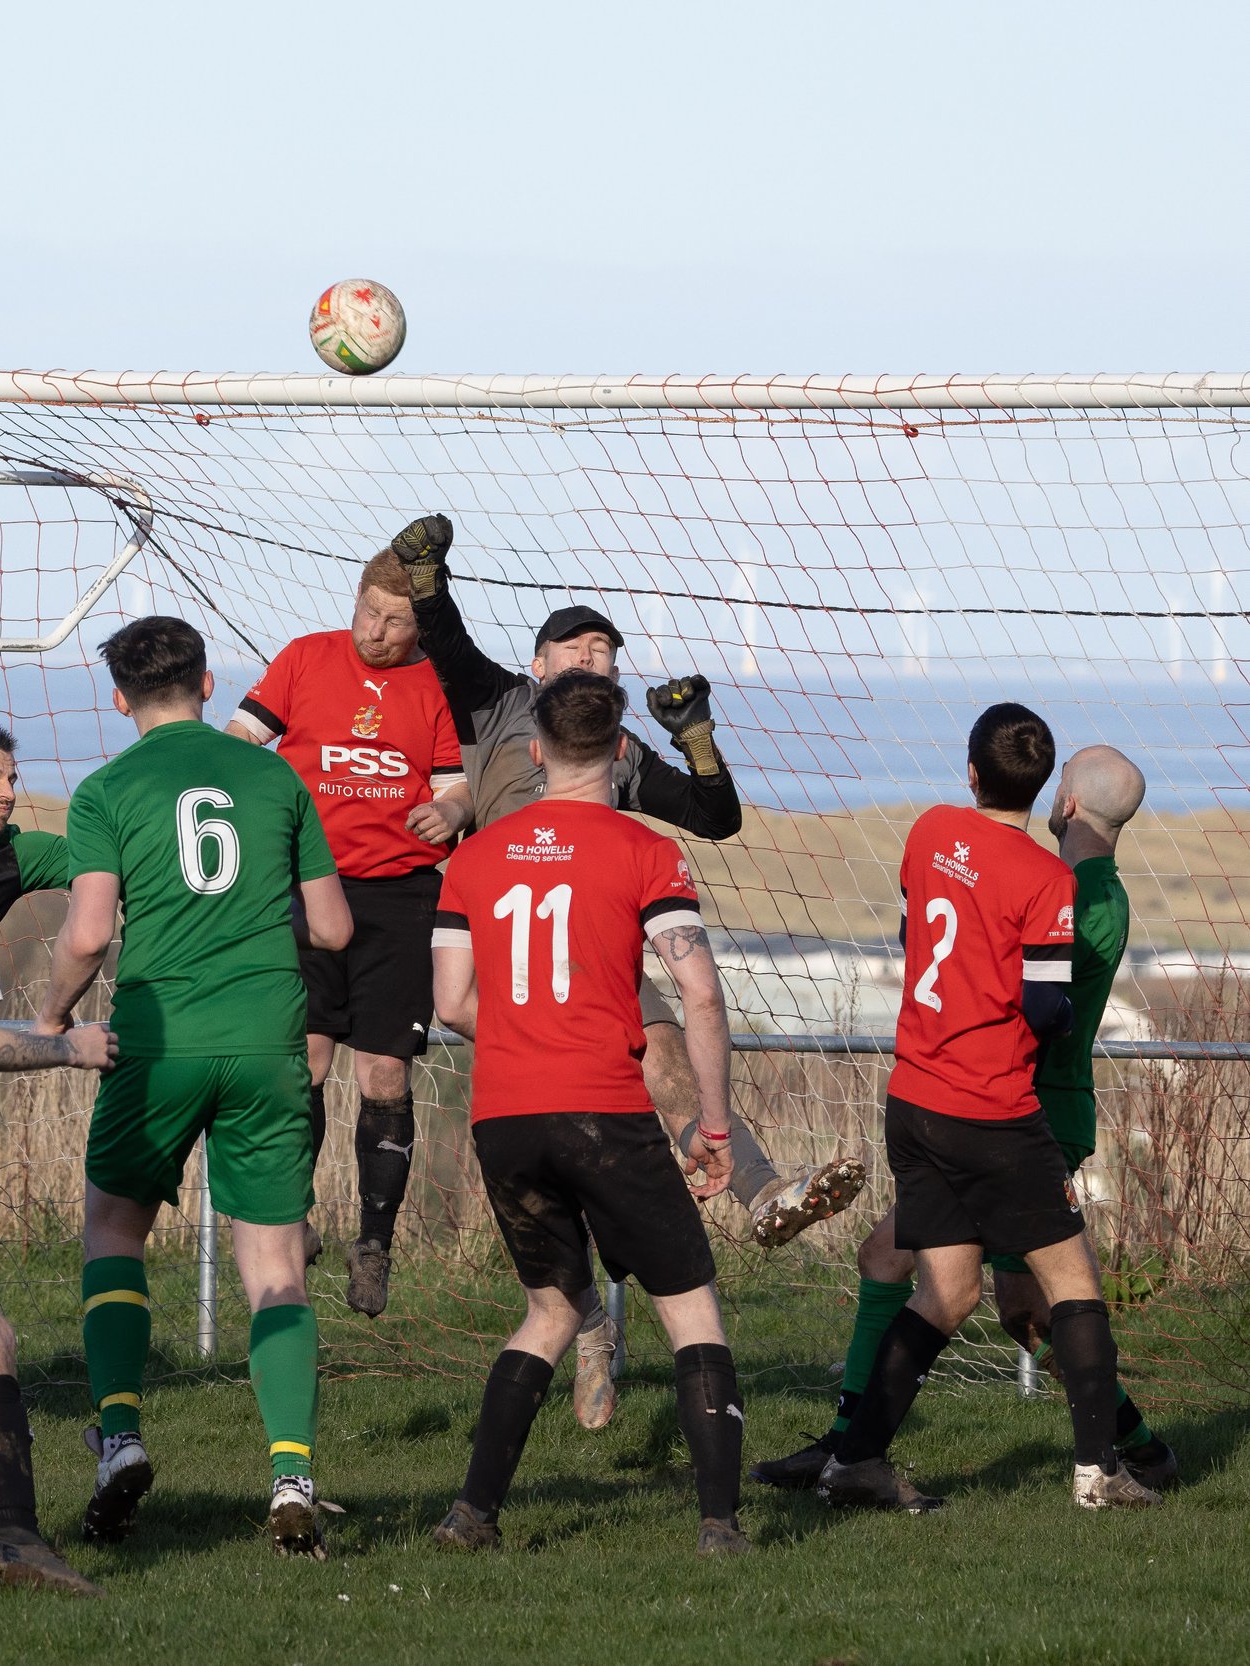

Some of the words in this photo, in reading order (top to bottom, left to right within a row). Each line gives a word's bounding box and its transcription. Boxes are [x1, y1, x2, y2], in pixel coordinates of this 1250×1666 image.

[321, 745, 409, 777] PSS
[318, 782, 353, 797] AUTO
[356, 787, 405, 798] CENTRE
[176, 787, 240, 894] 6
[507, 844, 524, 853] RG
[526, 845, 574, 854] HOWELLS
[506, 853, 540, 863] cleaning
[542, 854, 572, 862] services
[933, 852, 945, 863] RG
[945, 857, 979, 881] HOWELLS
[931, 861, 955, 878] cleaning
[954, 872, 975, 888] services
[493, 883, 573, 1006] 11
[914, 897, 957, 1013] 2
